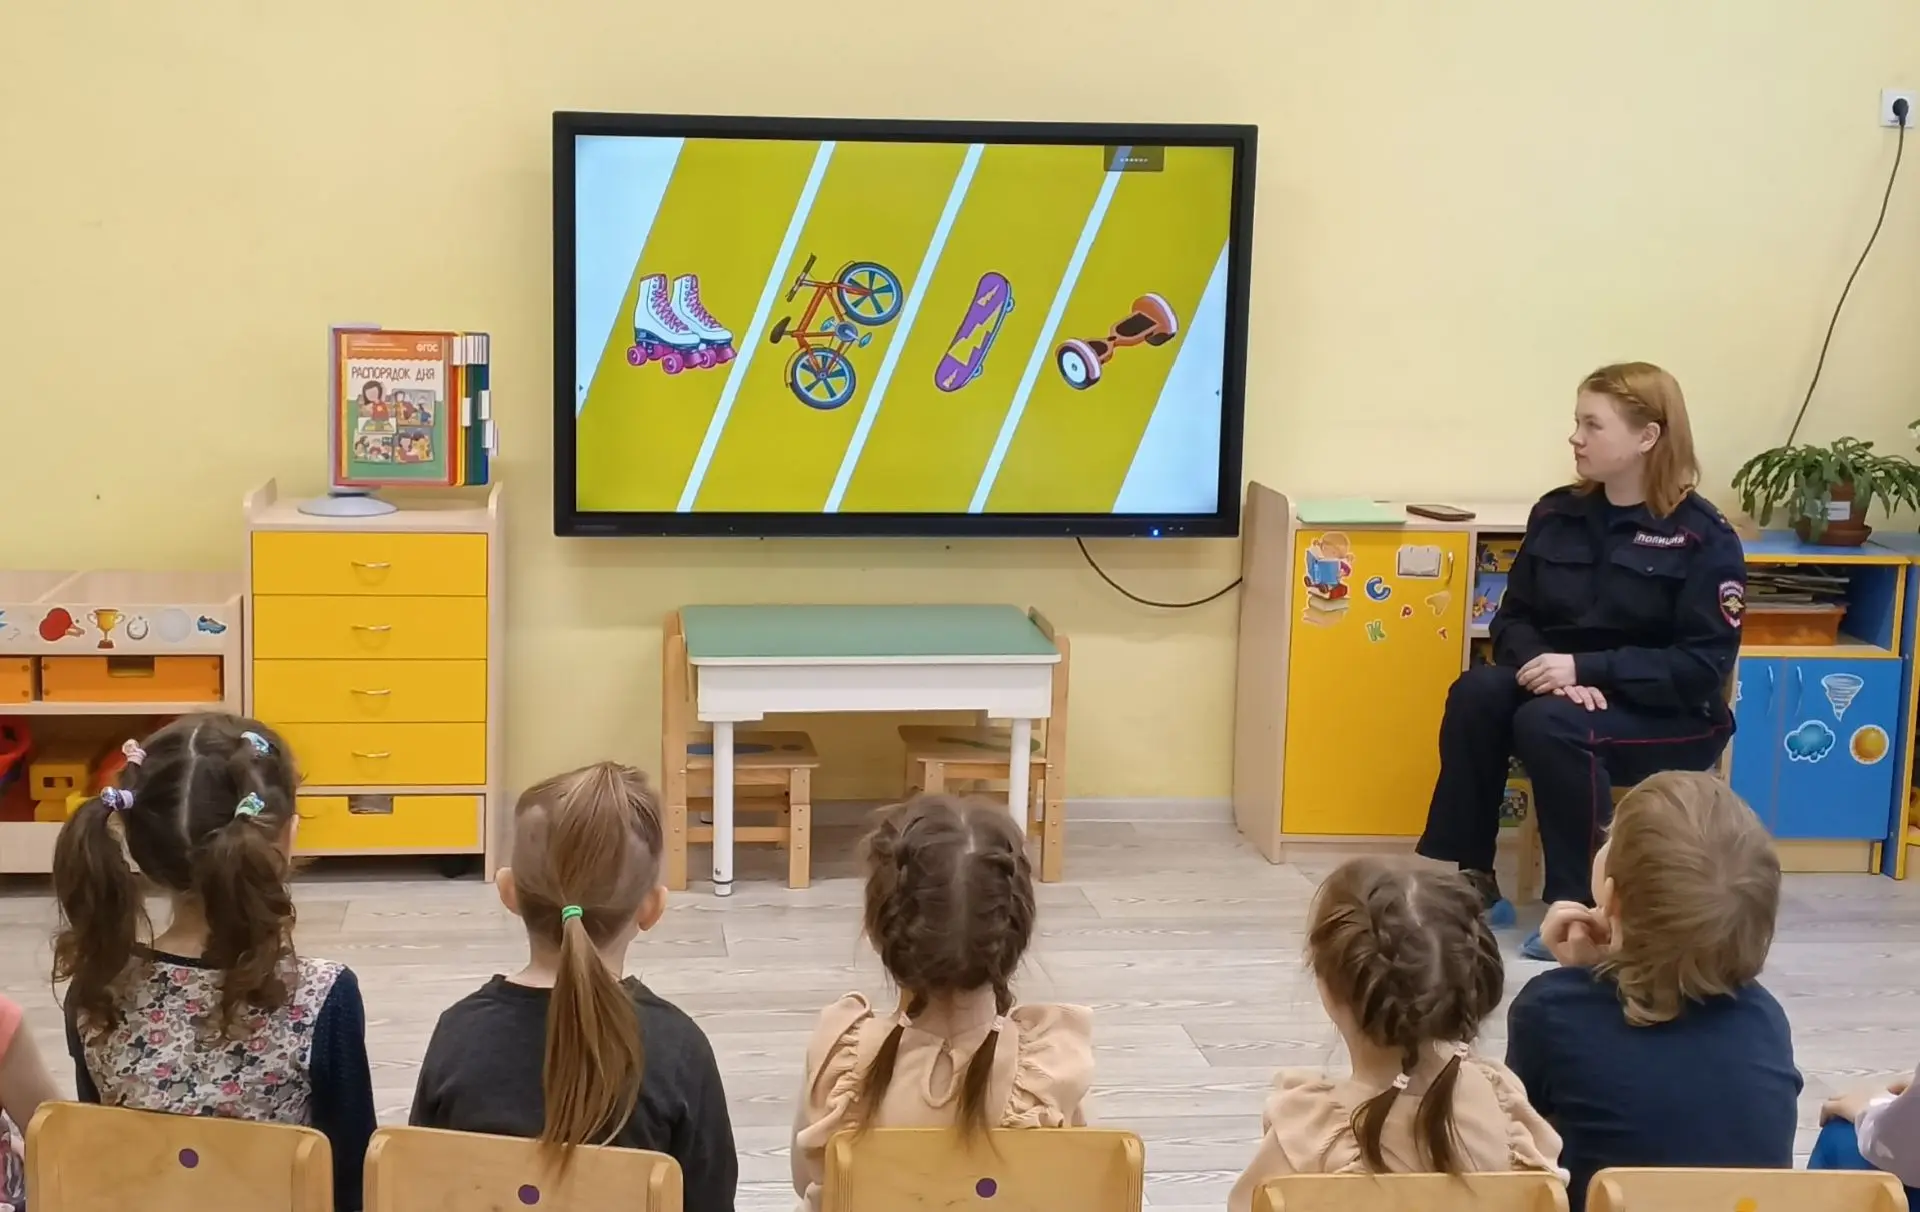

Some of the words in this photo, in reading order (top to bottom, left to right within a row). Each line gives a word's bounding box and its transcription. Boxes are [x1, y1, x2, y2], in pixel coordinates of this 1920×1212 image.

[416, 343, 438, 352] ФГОС
[352, 366, 410, 381] РАСПОРЯДОК
[415, 368, 435, 381] ДНЯ
[1637, 533, 1685, 546] ПОЛИЦИЯ
